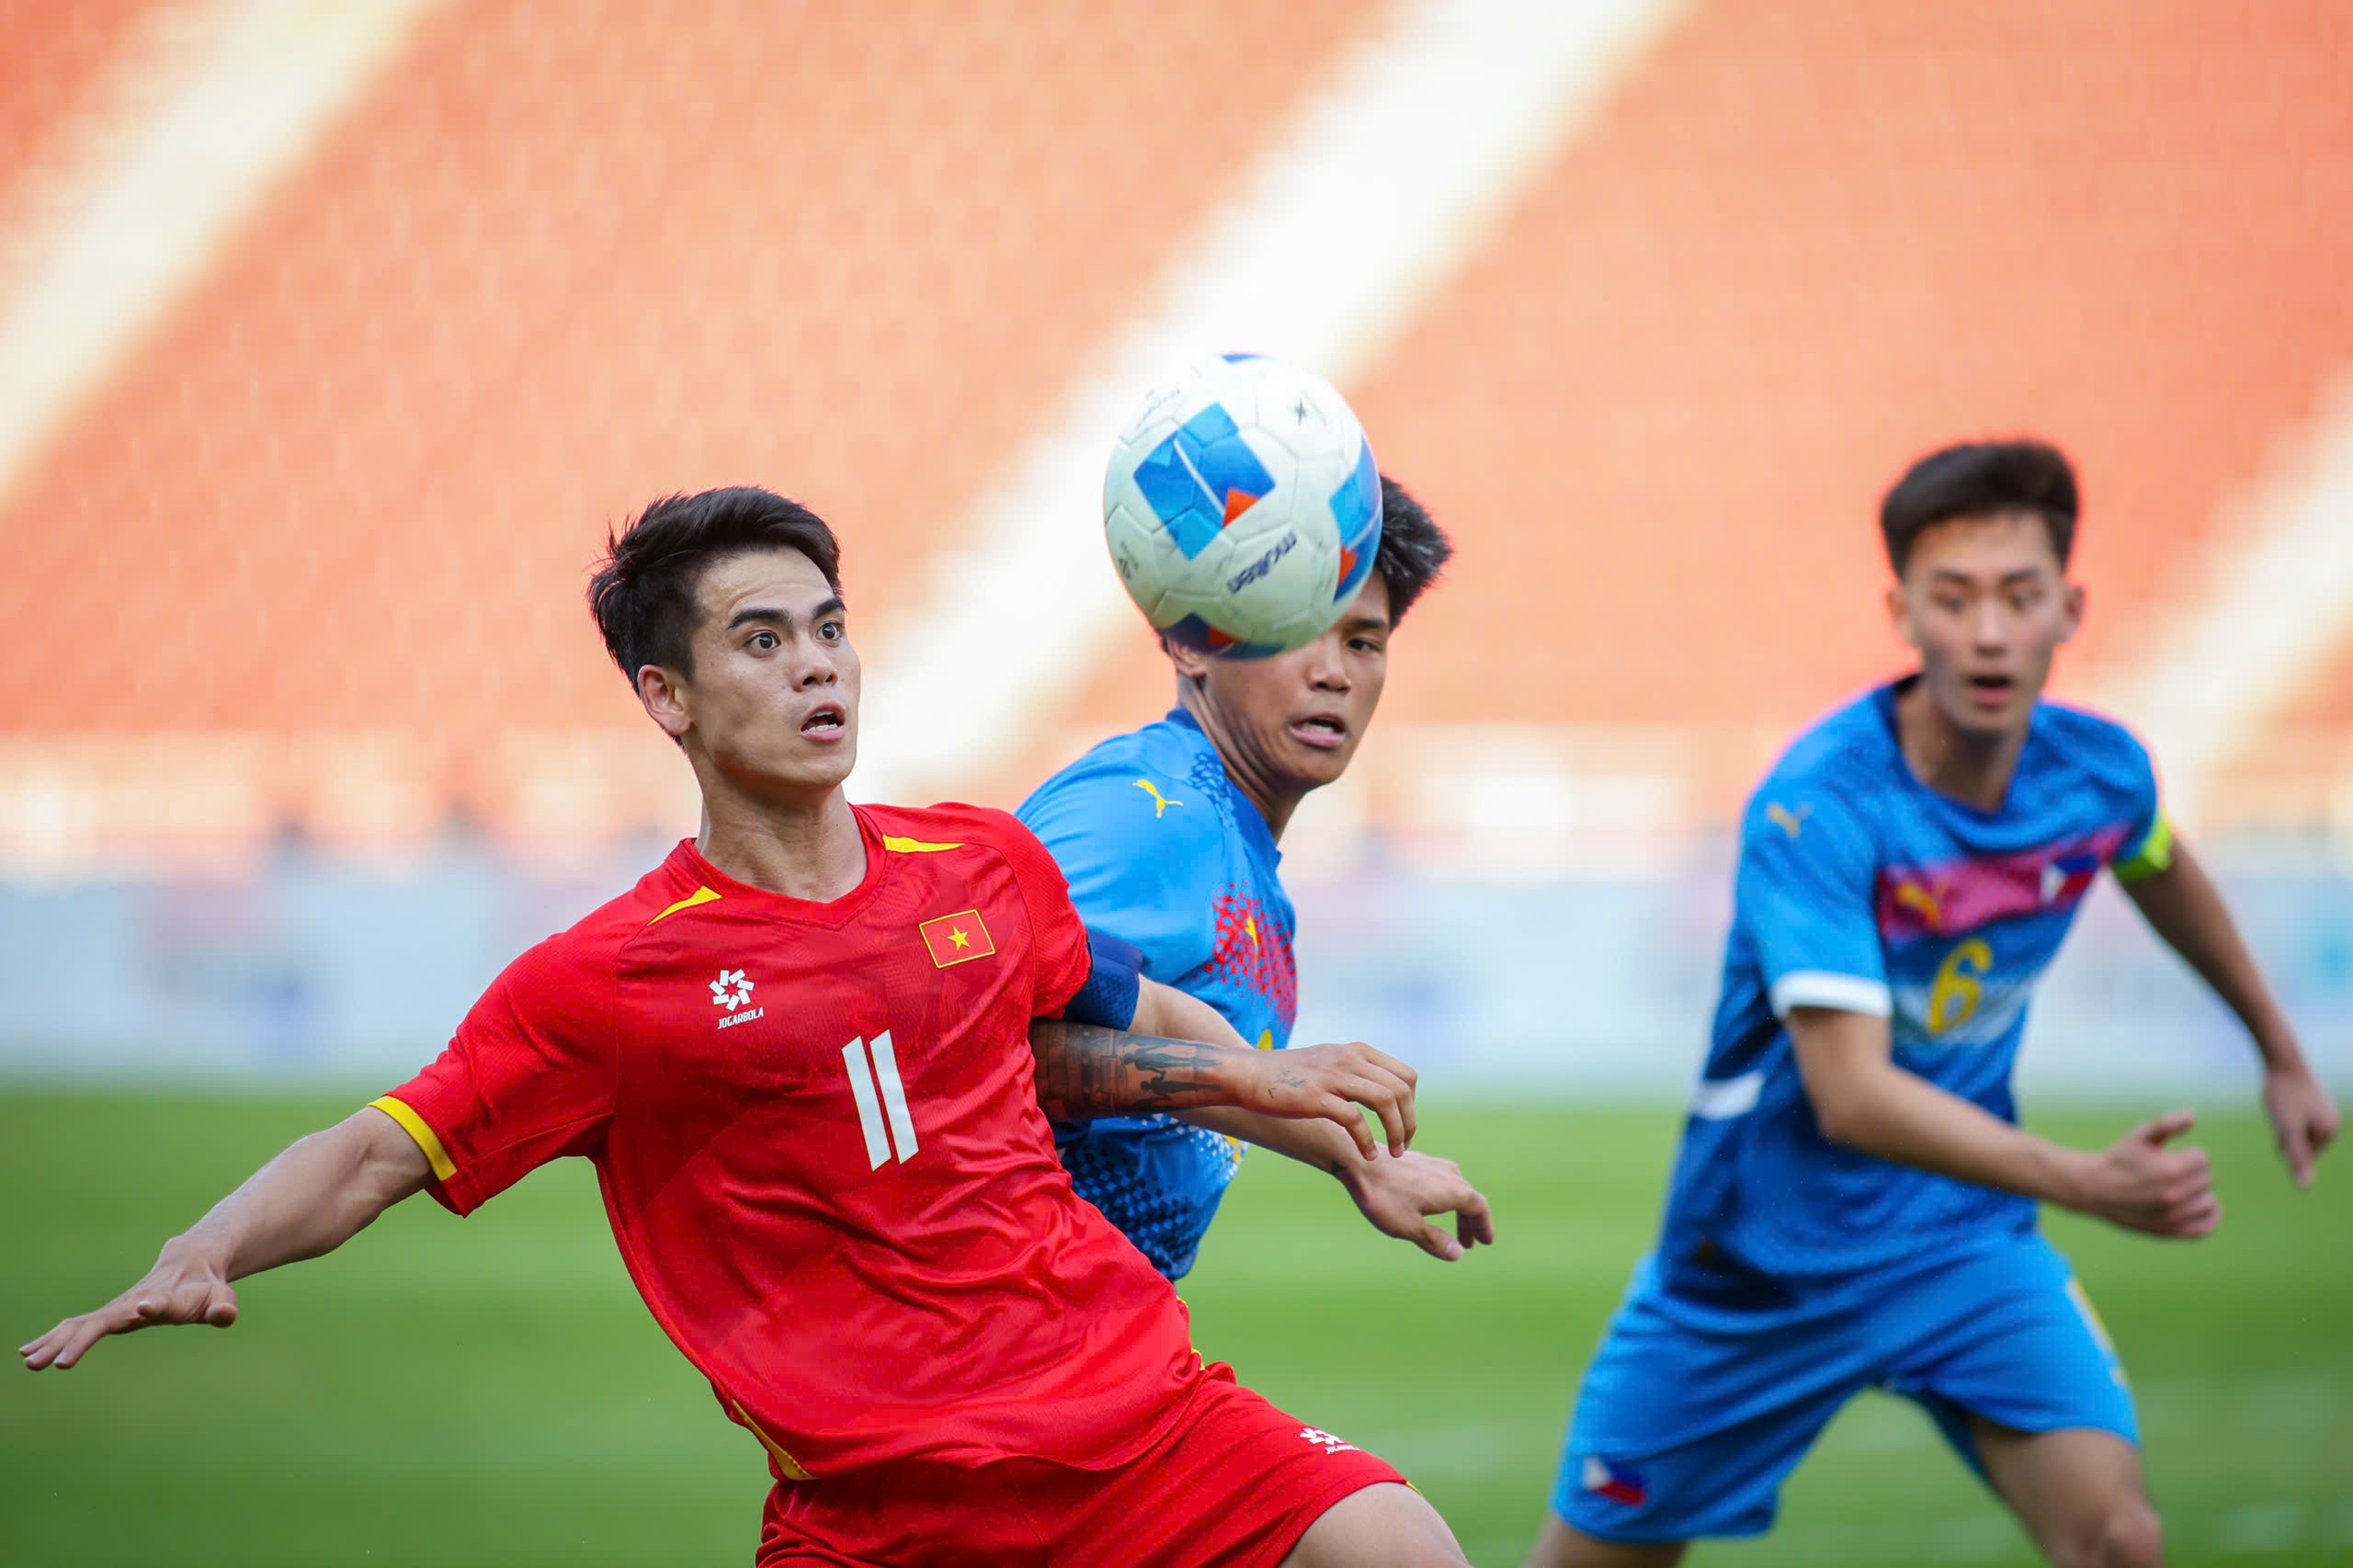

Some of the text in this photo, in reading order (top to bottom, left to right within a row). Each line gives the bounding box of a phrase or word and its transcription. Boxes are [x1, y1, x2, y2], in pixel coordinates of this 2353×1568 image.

[717, 1006, 765, 1029] JOGARBOLA
[1928, 939, 1994, 1035] 6
[841, 1029, 919, 1171] 11
